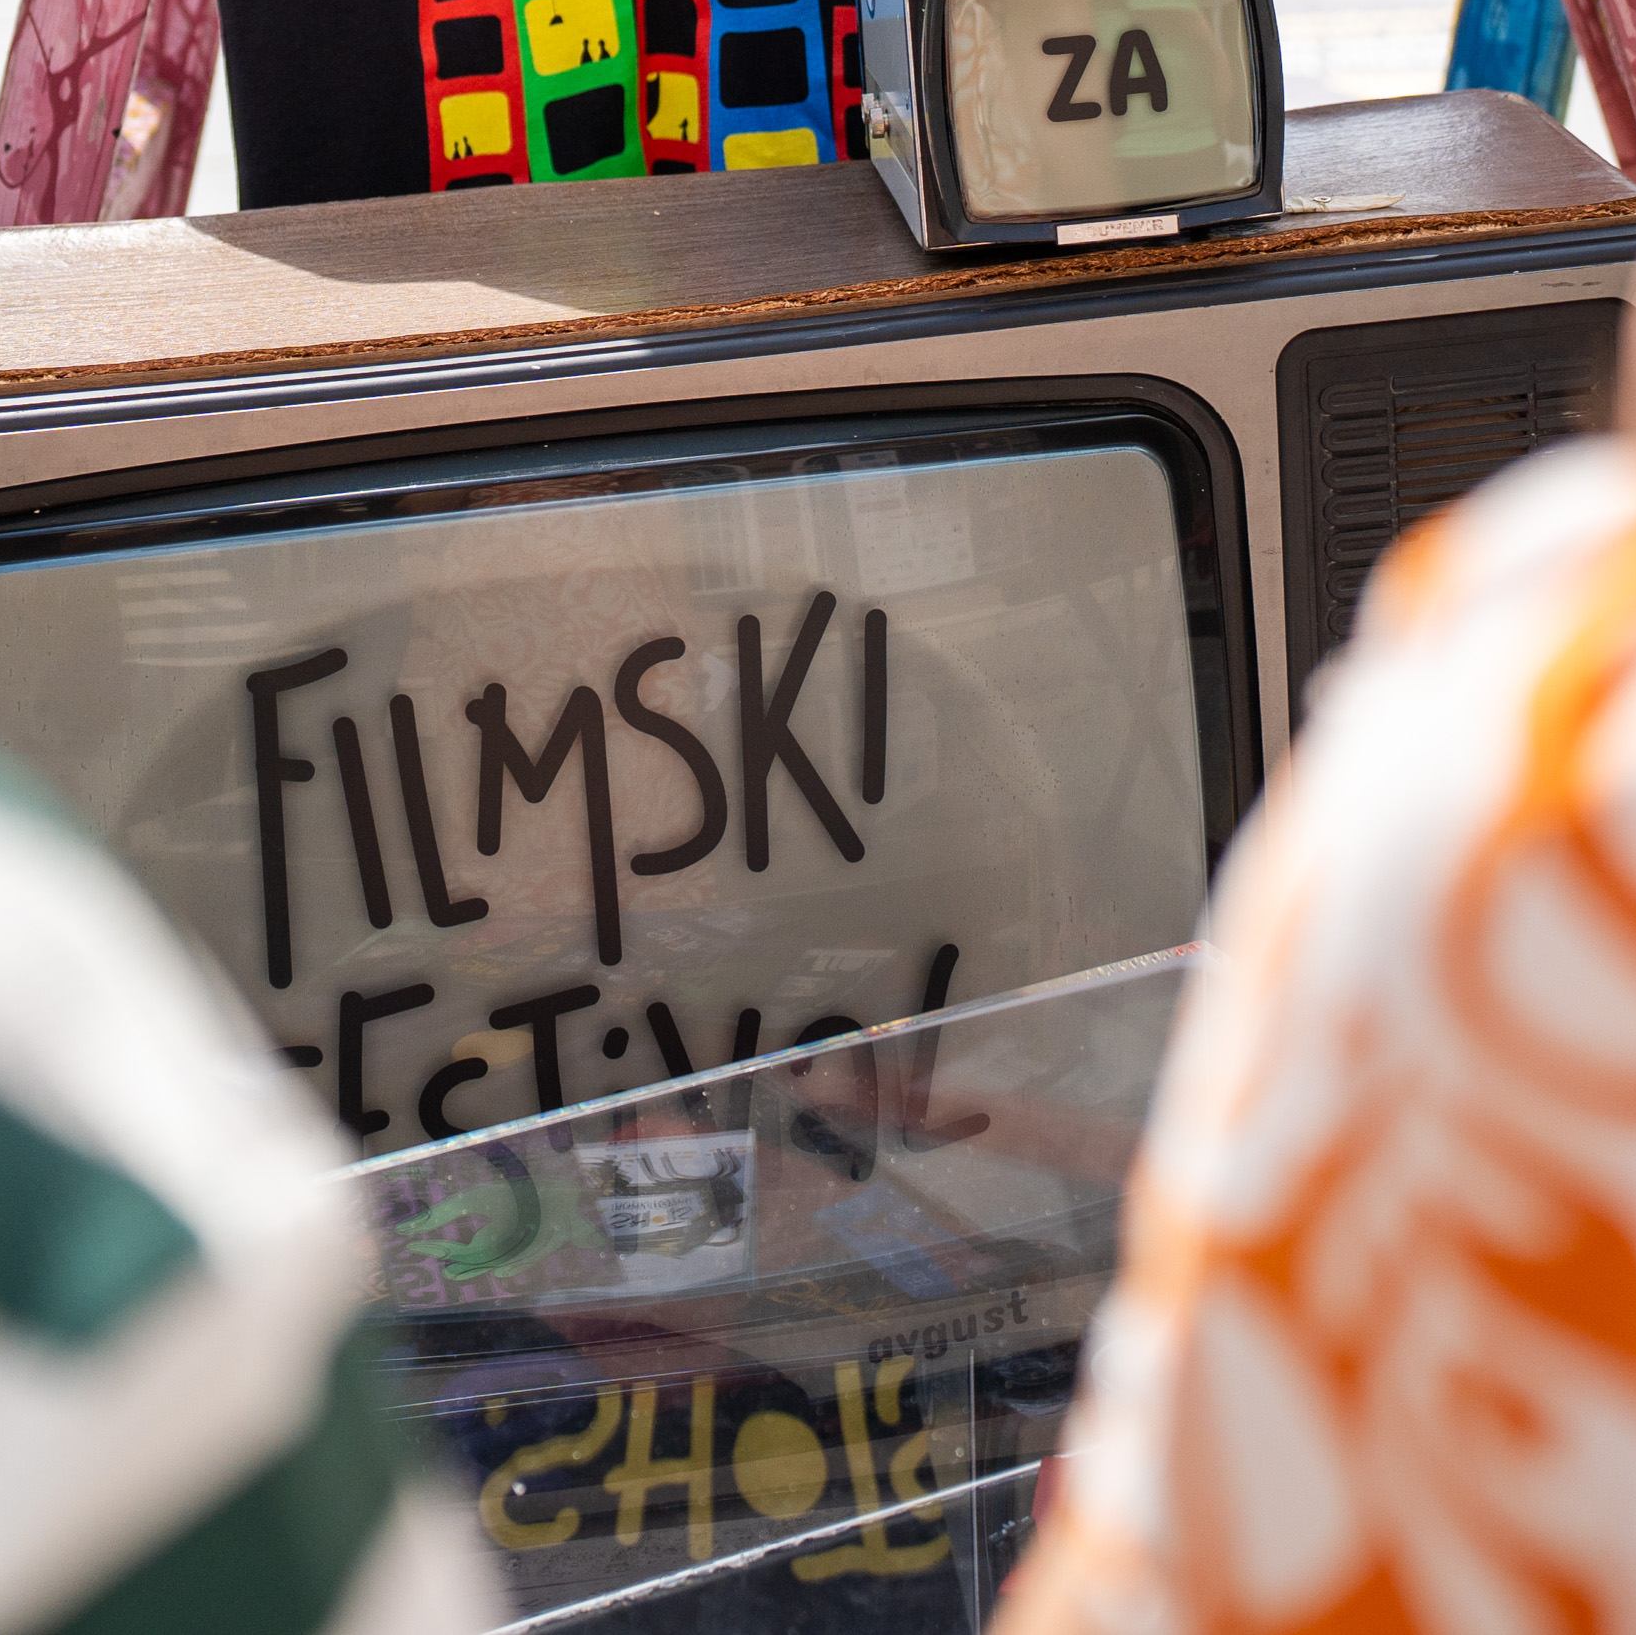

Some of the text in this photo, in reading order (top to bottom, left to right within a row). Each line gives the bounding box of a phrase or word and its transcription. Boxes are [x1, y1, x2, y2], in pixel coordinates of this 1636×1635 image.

[1041, 29, 1169, 124] ZA
[1073, 219, 1164, 239] SOUVENIR
[246, 590, 888, 990] FILMSKI
[868, 1290, 1030, 1364] avgust
